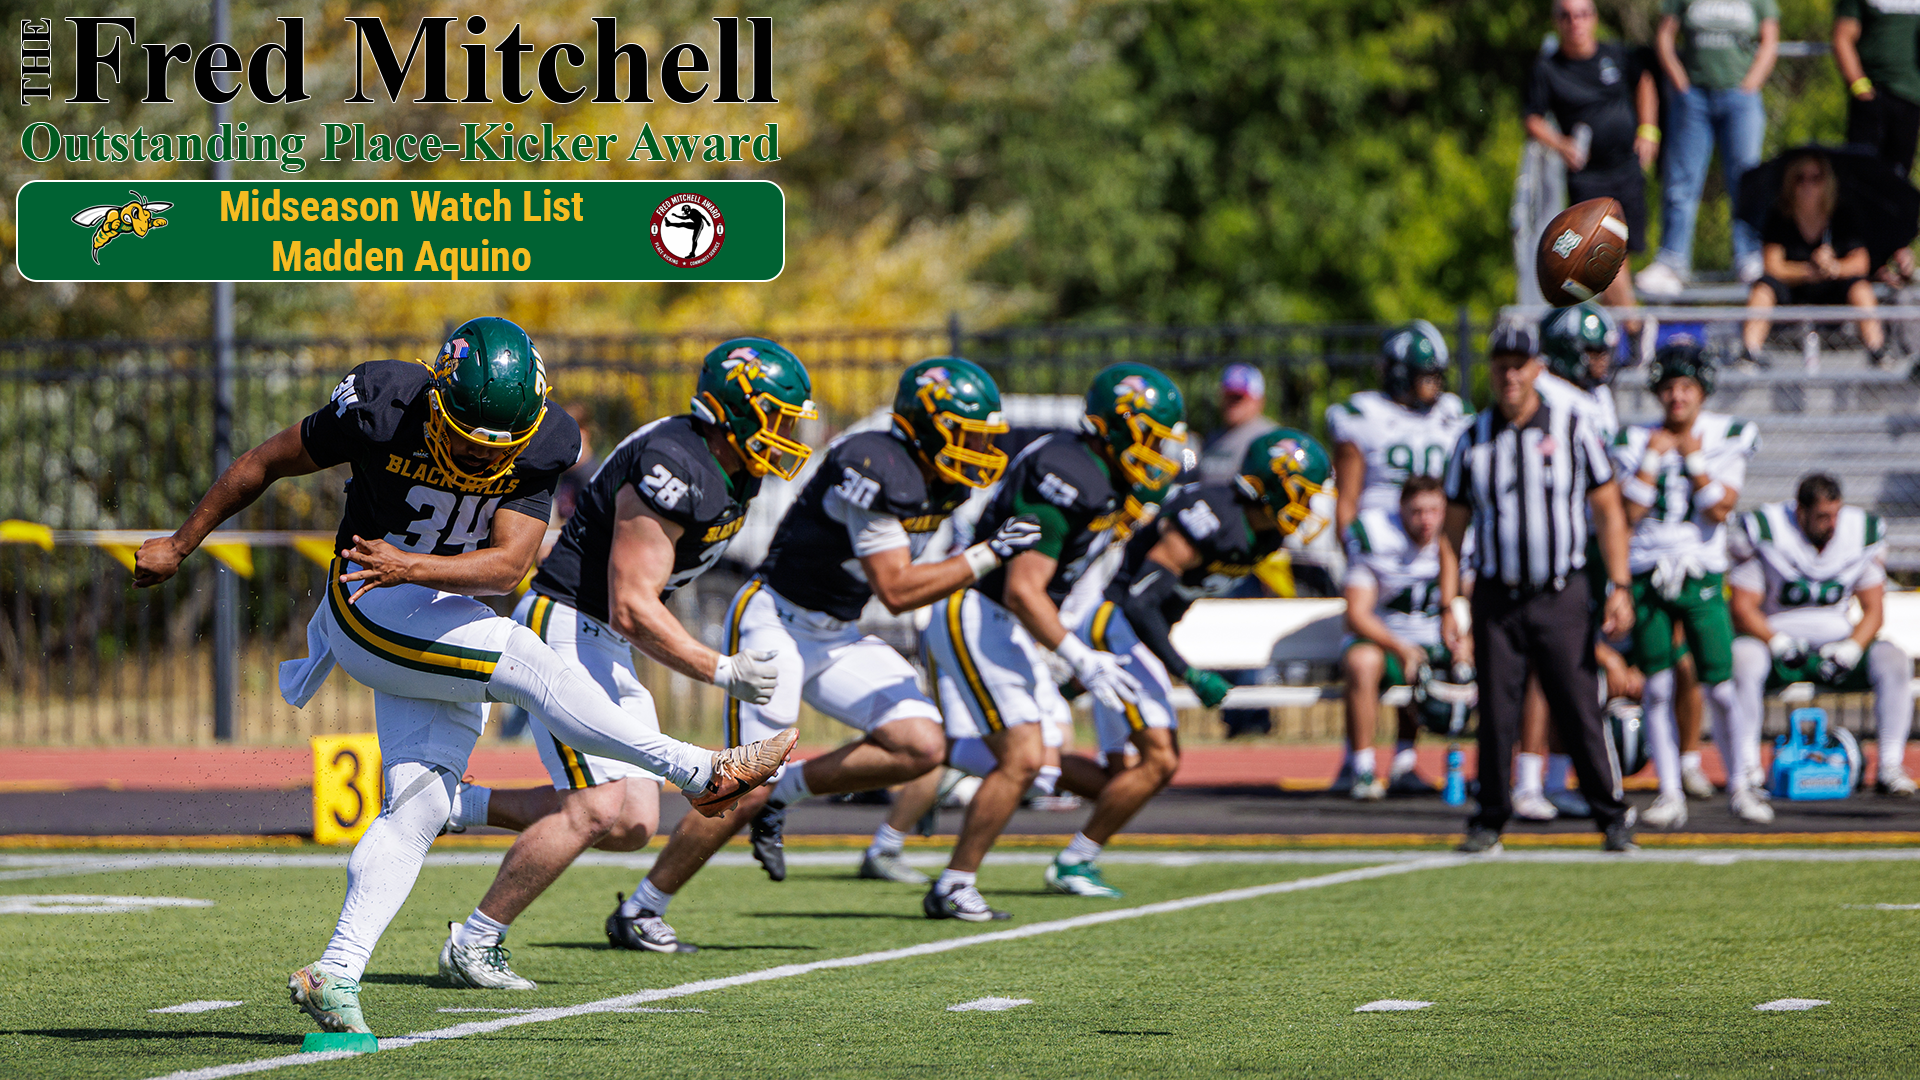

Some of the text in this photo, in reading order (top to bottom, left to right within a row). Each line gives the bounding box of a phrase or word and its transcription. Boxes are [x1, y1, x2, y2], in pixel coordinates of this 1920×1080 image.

[331, 374, 359, 418] 34
[386, 453, 458, 489] BLACK
[638, 463, 689, 511] 28
[834, 465, 881, 510] 30
[383, 484, 504, 554] 34
